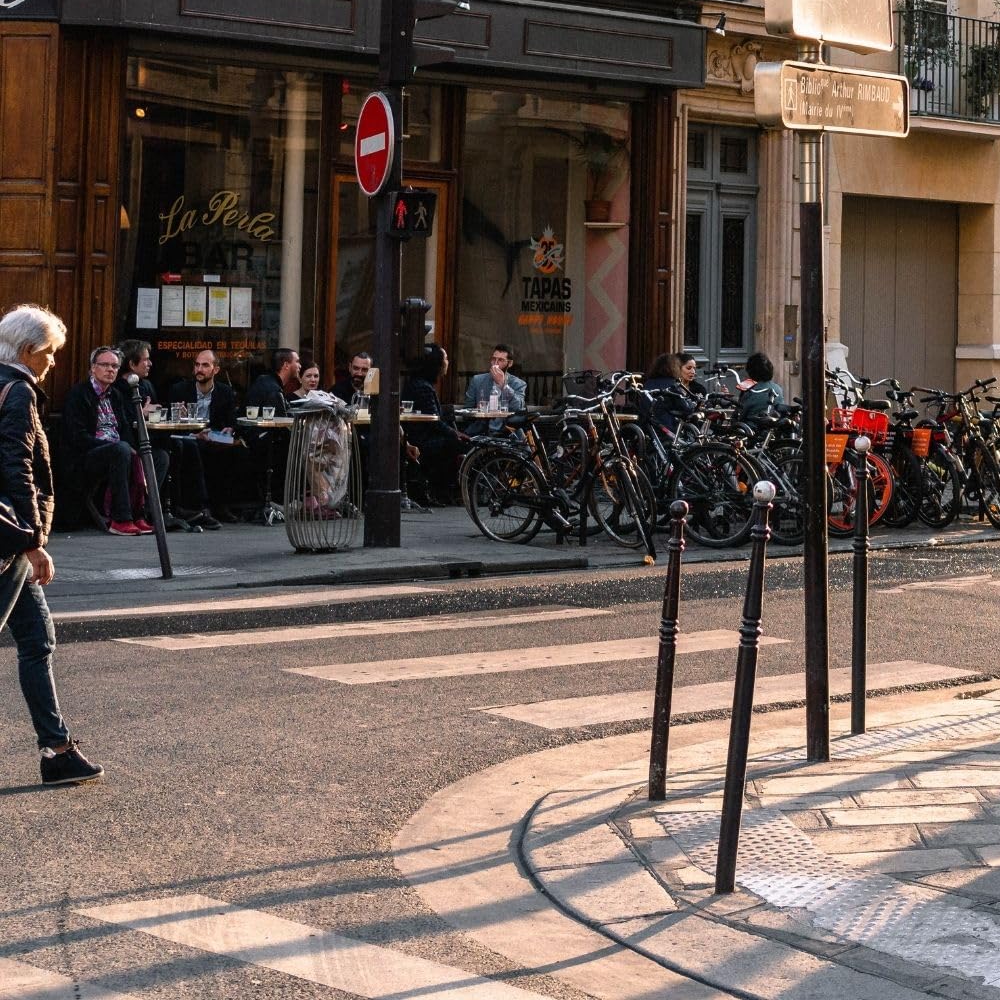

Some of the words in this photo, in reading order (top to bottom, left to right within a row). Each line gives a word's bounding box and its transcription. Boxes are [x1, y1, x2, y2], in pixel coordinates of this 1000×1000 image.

[831, 80, 854, 99] Arthur
[857, 83, 891, 103] RIMBAUD
[824, 105, 833, 118] du
[158, 195, 199, 245] La
[202, 190, 276, 242] Perla
[182, 241, 253, 271] BAR
[522, 276, 572, 300] TAPAS
[521, 301, 572, 313] MEXICAINS
[157, 341, 213, 350] ESPECIALIDAD
[216, 341, 227, 350] EN
